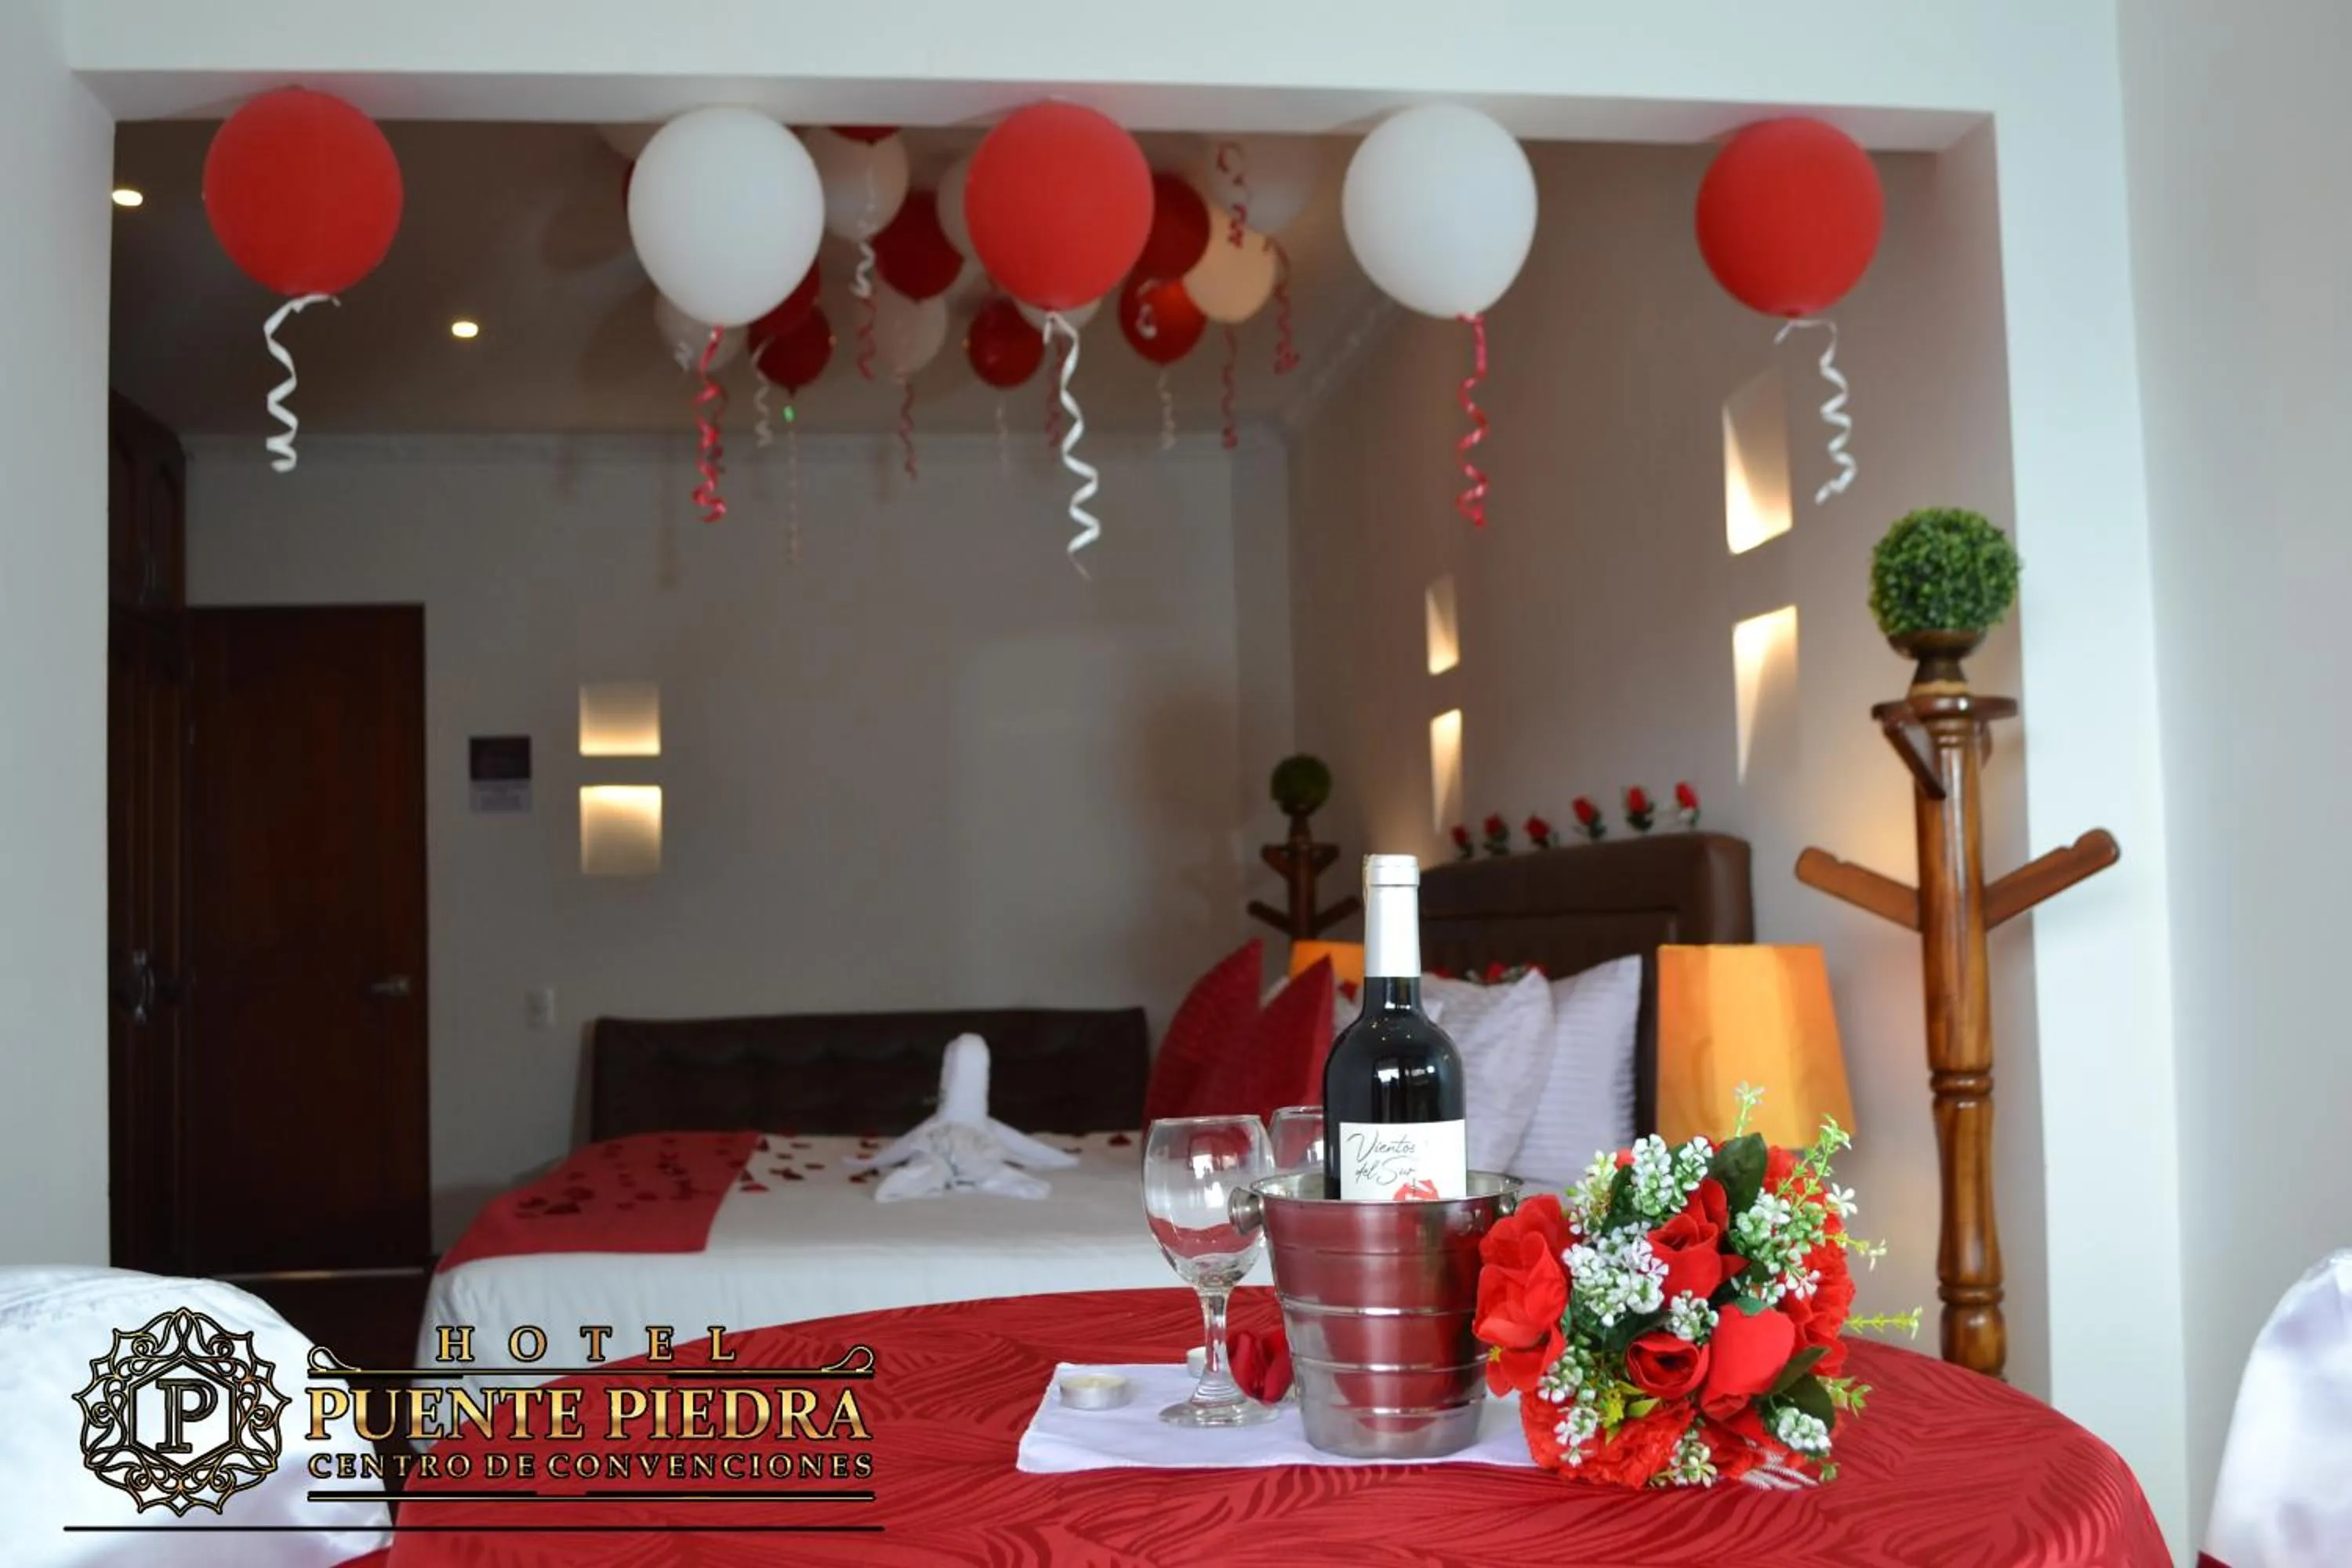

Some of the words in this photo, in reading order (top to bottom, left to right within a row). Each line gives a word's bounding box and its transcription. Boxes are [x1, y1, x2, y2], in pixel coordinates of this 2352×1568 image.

[1346, 1131, 1415, 1163] Vientos
[1355, 1160, 1377, 1184] del
[1376, 1156, 1415, 1185] Sur
